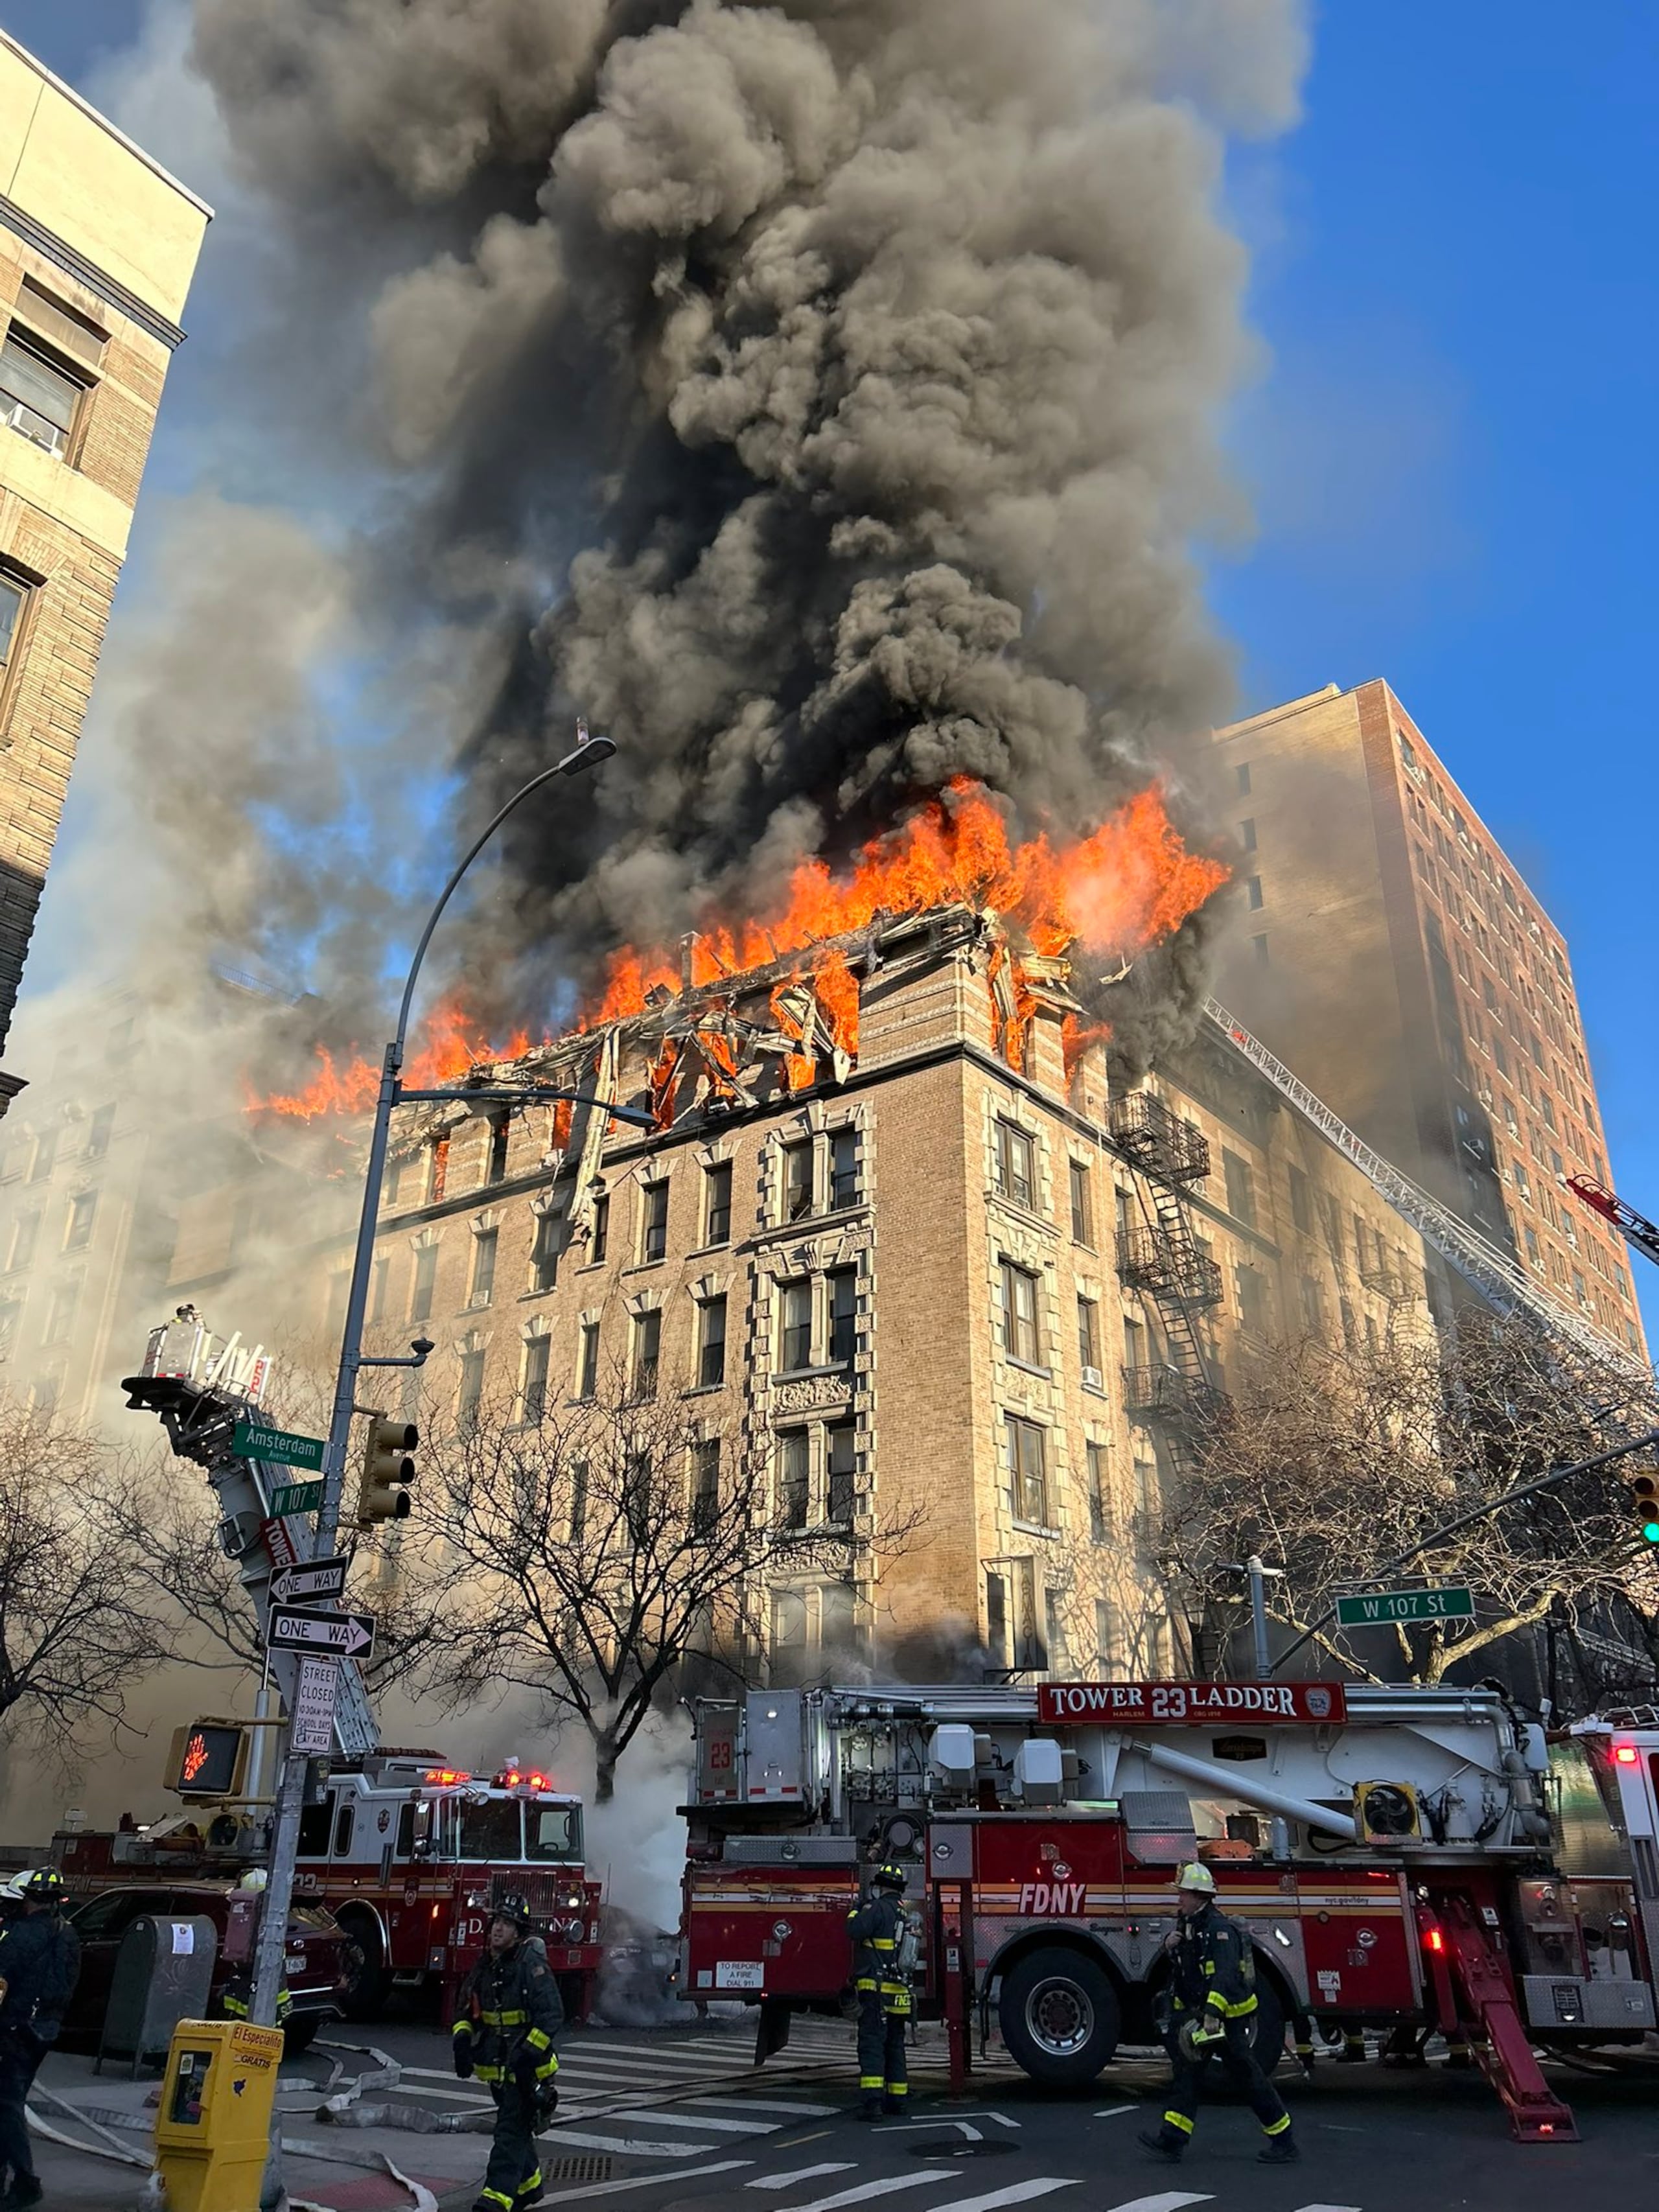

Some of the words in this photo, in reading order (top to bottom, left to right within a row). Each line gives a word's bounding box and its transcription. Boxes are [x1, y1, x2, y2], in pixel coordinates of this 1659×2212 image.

[246, 1428, 316, 1457] Amsterdam
[268, 1450, 291, 1462] Avenue
[274, 1491, 285, 1513] W
[288, 1486, 308, 1510] 107
[265, 1519, 292, 1567] TOWE
[278, 1576, 301, 1595] ONE
[314, 1569, 340, 1589] WAY
[1363, 1600, 1379, 1618] W
[1387, 1596, 1418, 1616] 107
[1427, 1594, 1447, 1613] St
[279, 1618, 311, 1638] ONE
[329, 1625, 361, 1645] WAY
[304, 1666, 336, 1683] STREET
[301, 1685, 334, 1702] CLOSED
[1050, 1687, 1145, 1716] TOWER
[1152, 1687, 1187, 1717] 23
[1189, 1687, 1297, 1716] LADDER
[297, 1717, 317, 1729] SCHOOL
[313, 1735, 328, 1745] AREA
[711, 1741, 730, 1769] 23
[1019, 1883, 1086, 1914] FDNY
[234, 2027, 241, 2040] El
[242, 2028, 281, 2049] Especialito
[241, 2055, 272, 2069] GRATIS
